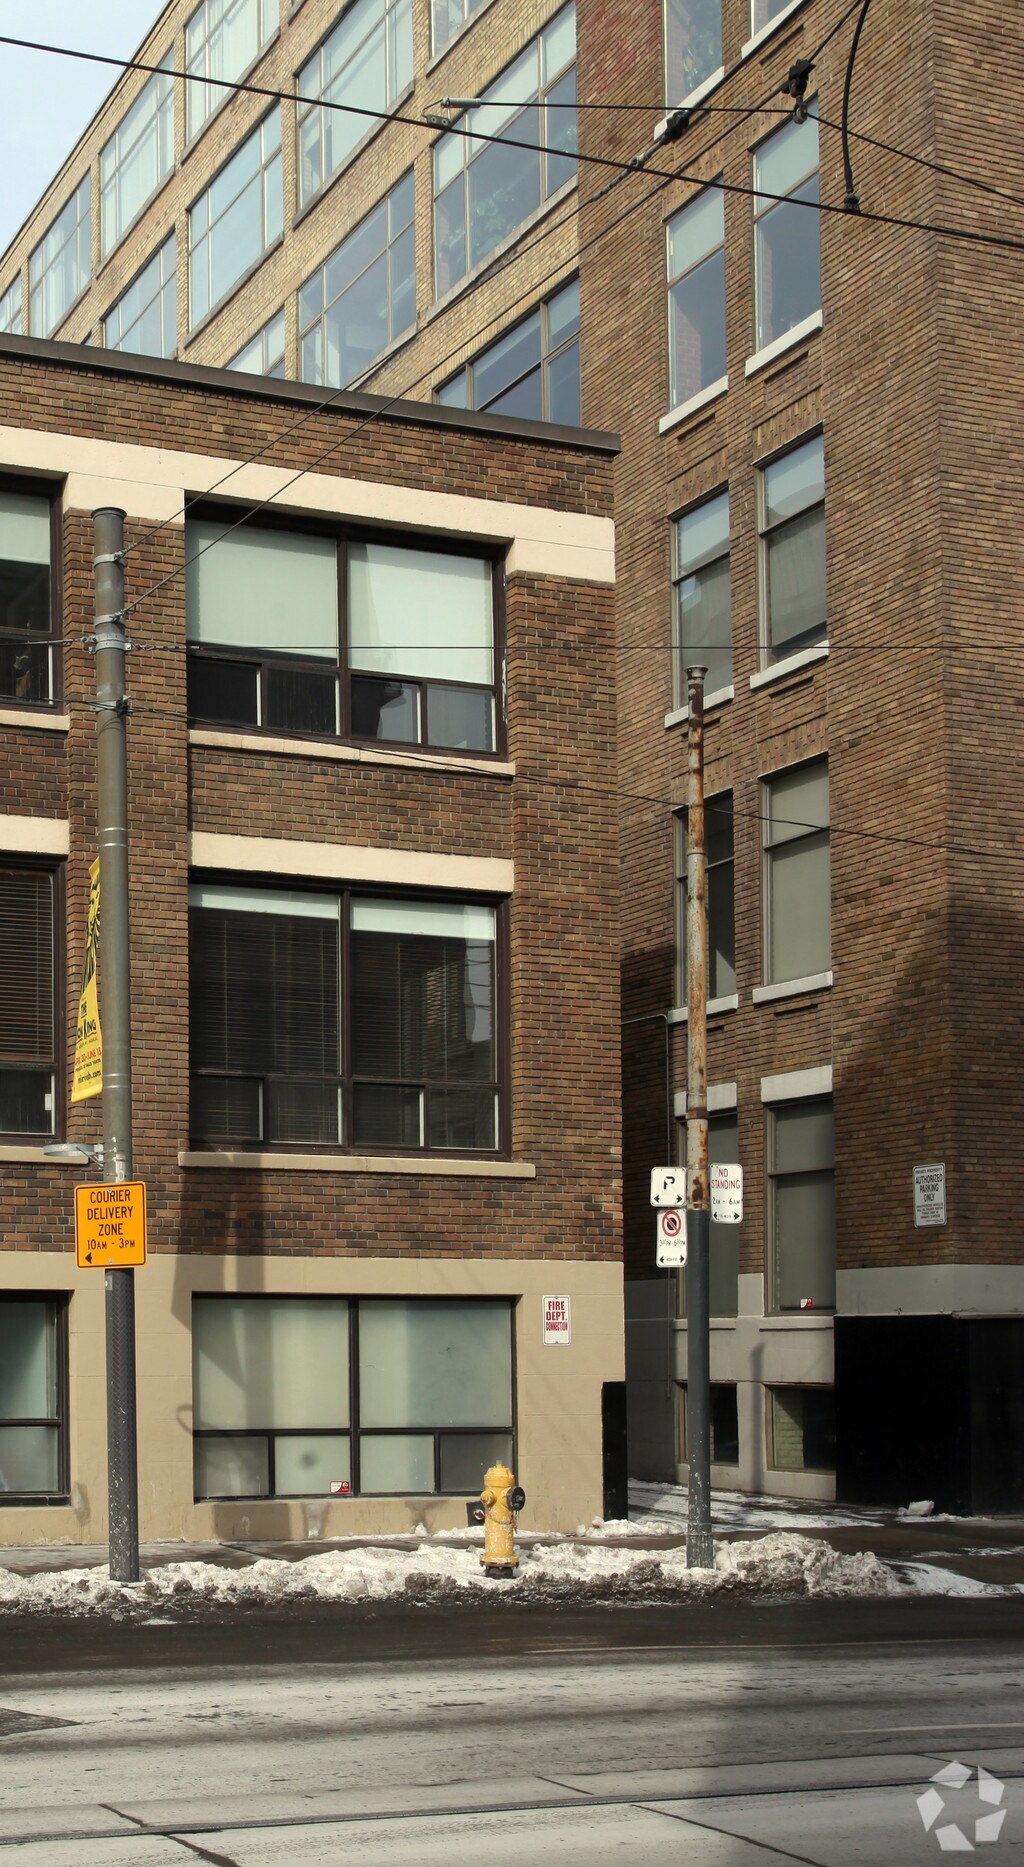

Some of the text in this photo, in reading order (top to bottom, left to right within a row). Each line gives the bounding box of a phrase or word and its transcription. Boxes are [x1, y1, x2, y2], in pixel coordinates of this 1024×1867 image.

[718, 1168, 729, 1178] NO
[916, 1173, 942, 1184] AUTHORIZED
[711, 1180, 741, 1189] STANDING
[920, 1184, 939, 1193] PARKING
[90, 1189, 131, 1203] COURIER
[924, 1193, 935, 1202] ONLY
[87, 1206, 134, 1221] DELIVERY
[98, 1223, 124, 1237] ZONE
[87, 1239, 107, 1250] 10AM
[118, 1237, 136, 1249] 3PM
[548, 1300, 565, 1311] FIRE
[546, 1311, 568, 1321] DEPT.
